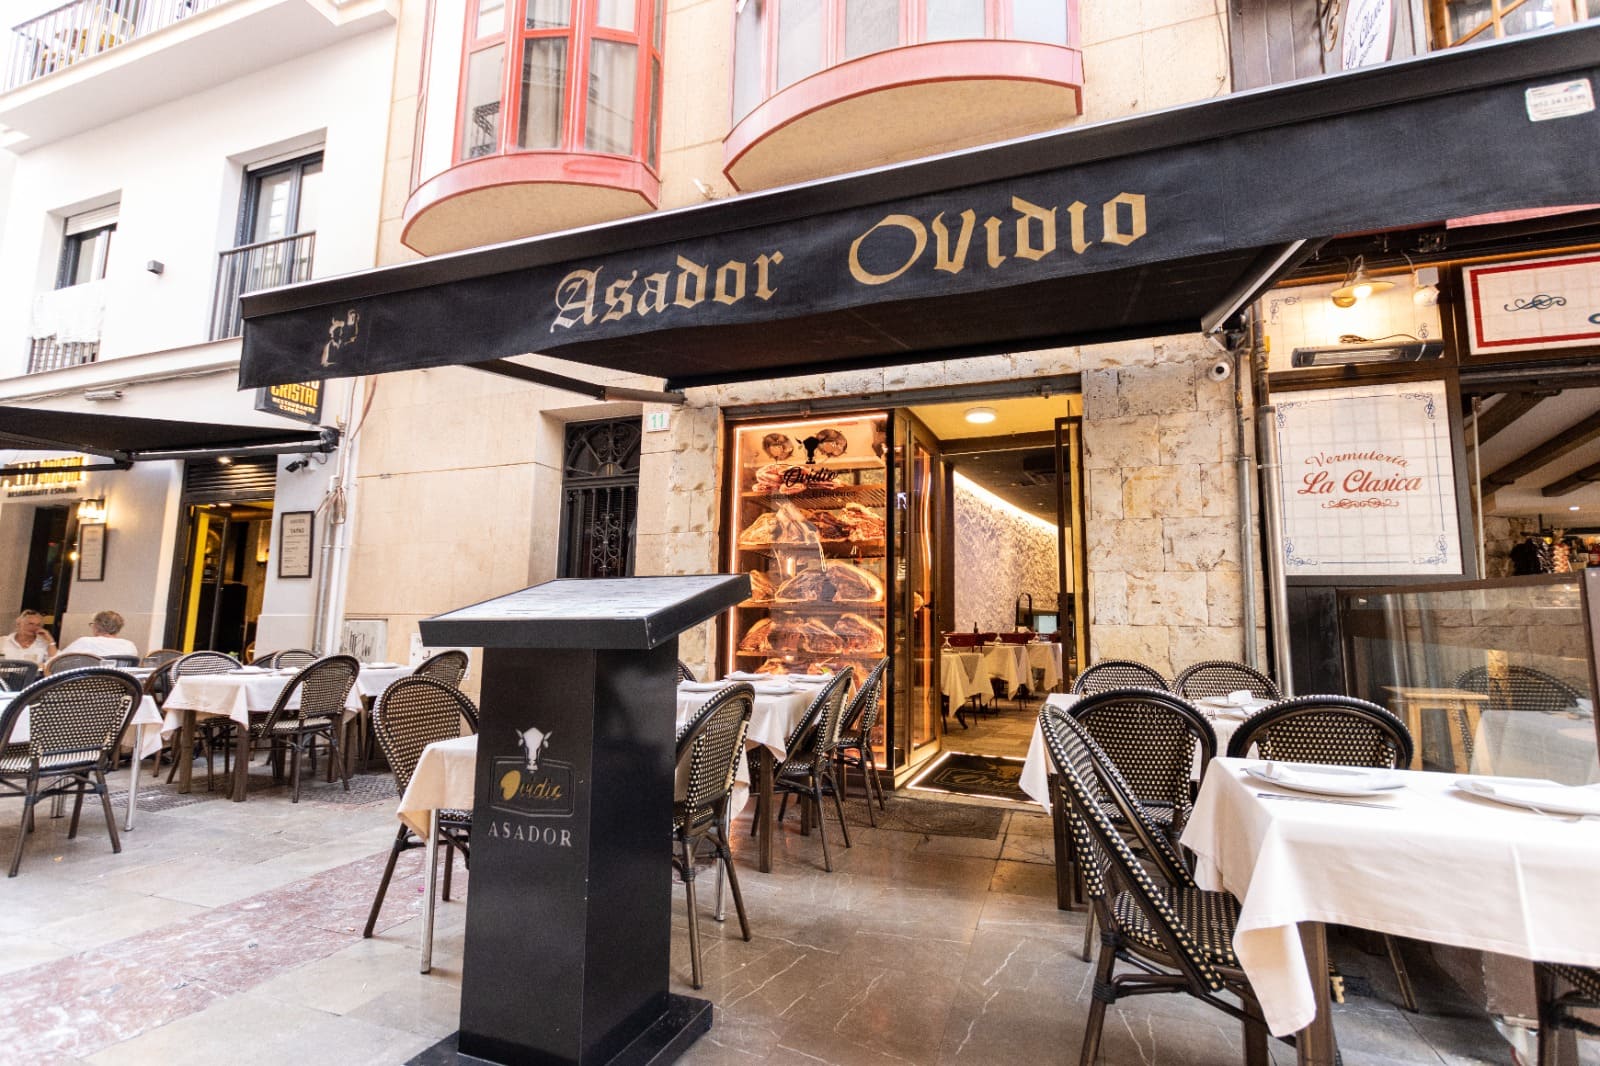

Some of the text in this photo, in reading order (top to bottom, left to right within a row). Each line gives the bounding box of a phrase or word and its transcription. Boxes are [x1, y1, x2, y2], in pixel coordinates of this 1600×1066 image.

[550, 192, 1147, 333] Asador Ovidio
[270, 383, 319, 408] CRISTAL
[783, 465, 838, 488] Ovidio
[1297, 469, 1423, 495] La Clasica
[488, 820, 572, 847] ASADOR
